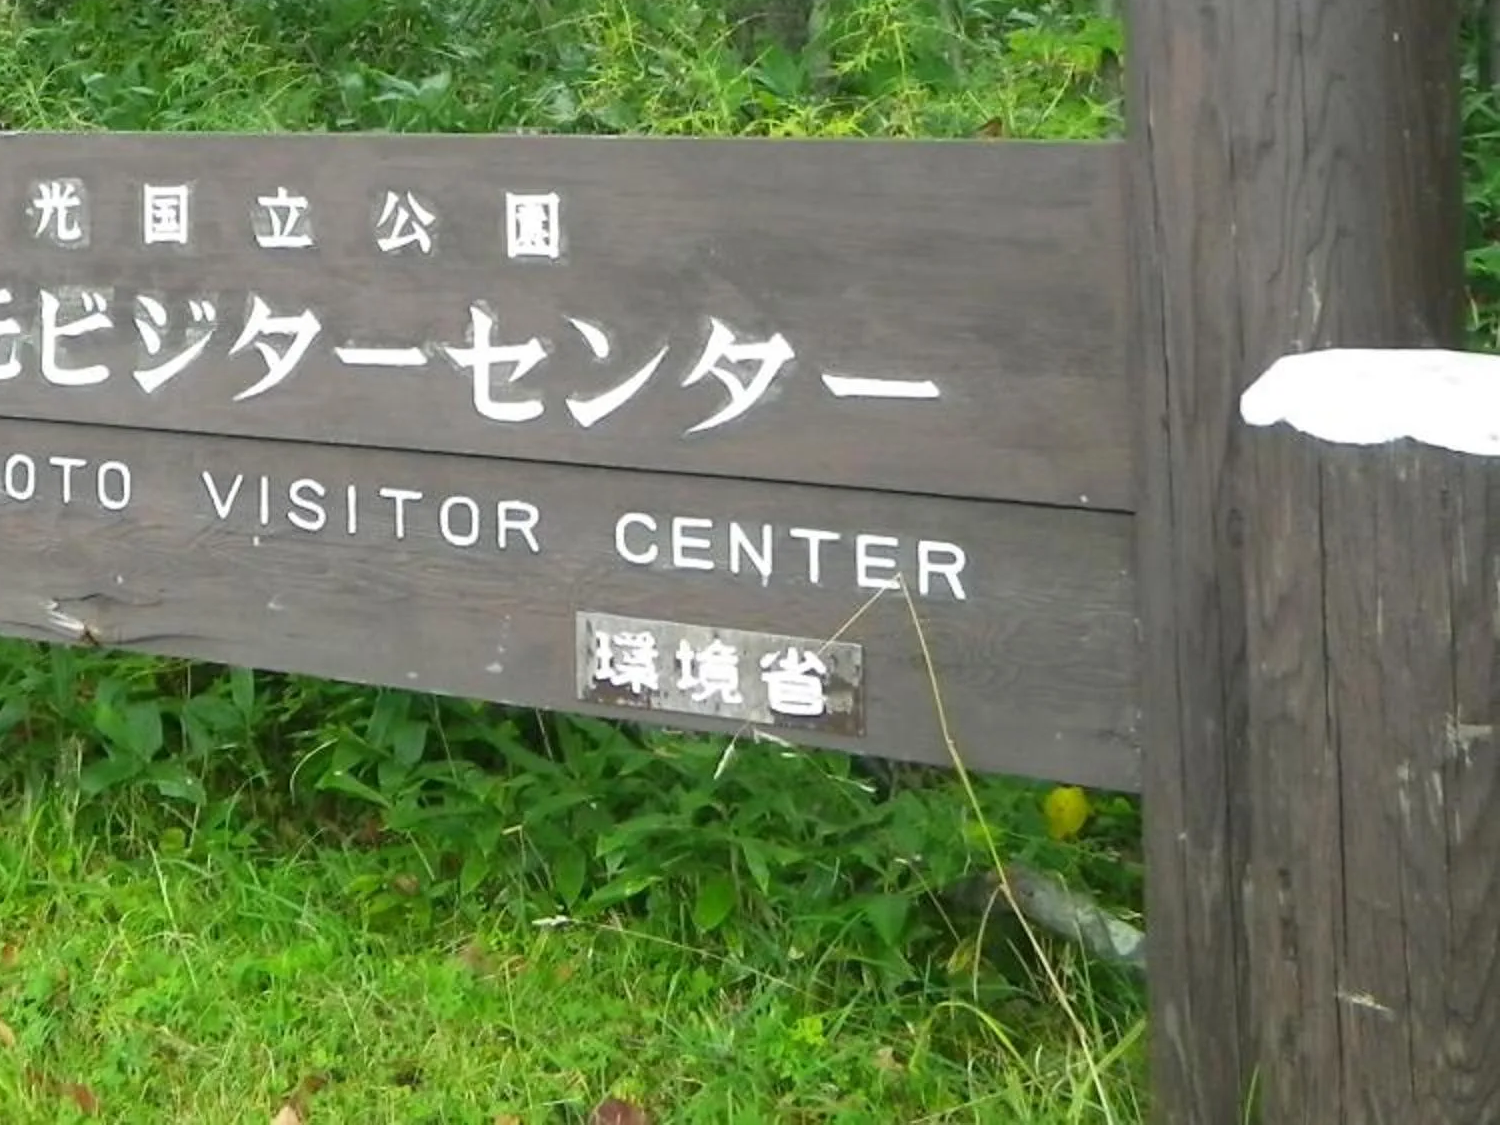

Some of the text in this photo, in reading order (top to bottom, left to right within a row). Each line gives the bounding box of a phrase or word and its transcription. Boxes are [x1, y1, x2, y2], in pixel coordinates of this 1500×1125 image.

[202, 471, 541, 553] VISITOR
[614, 512, 967, 600] CENTER
[593, 630, 827, 716] 環境省
